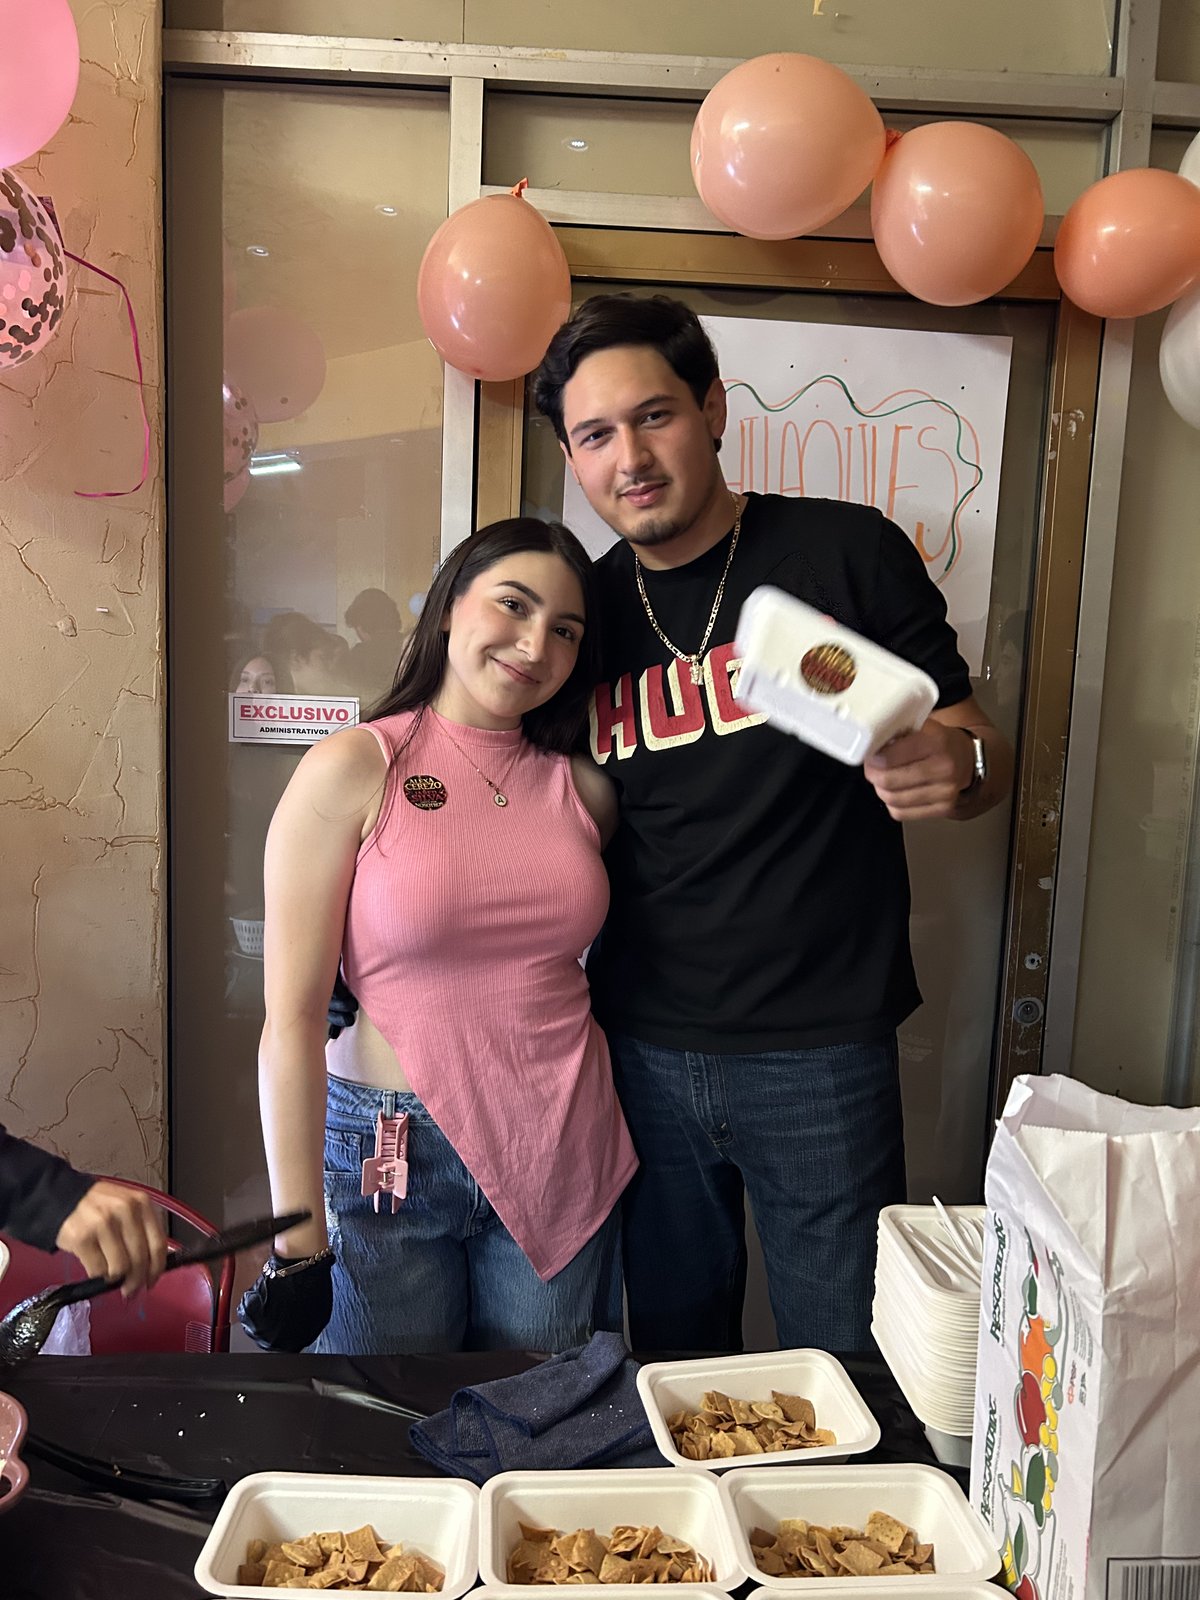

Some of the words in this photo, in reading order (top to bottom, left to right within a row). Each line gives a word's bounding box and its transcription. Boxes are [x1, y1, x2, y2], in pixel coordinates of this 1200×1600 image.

[587, 630, 800, 765] HUG
[240, 704, 350, 722] EXCLUSIVO
[259, 726, 330, 736] ADMINISTRATIVOS
[404, 781, 442, 790] CEREZO
